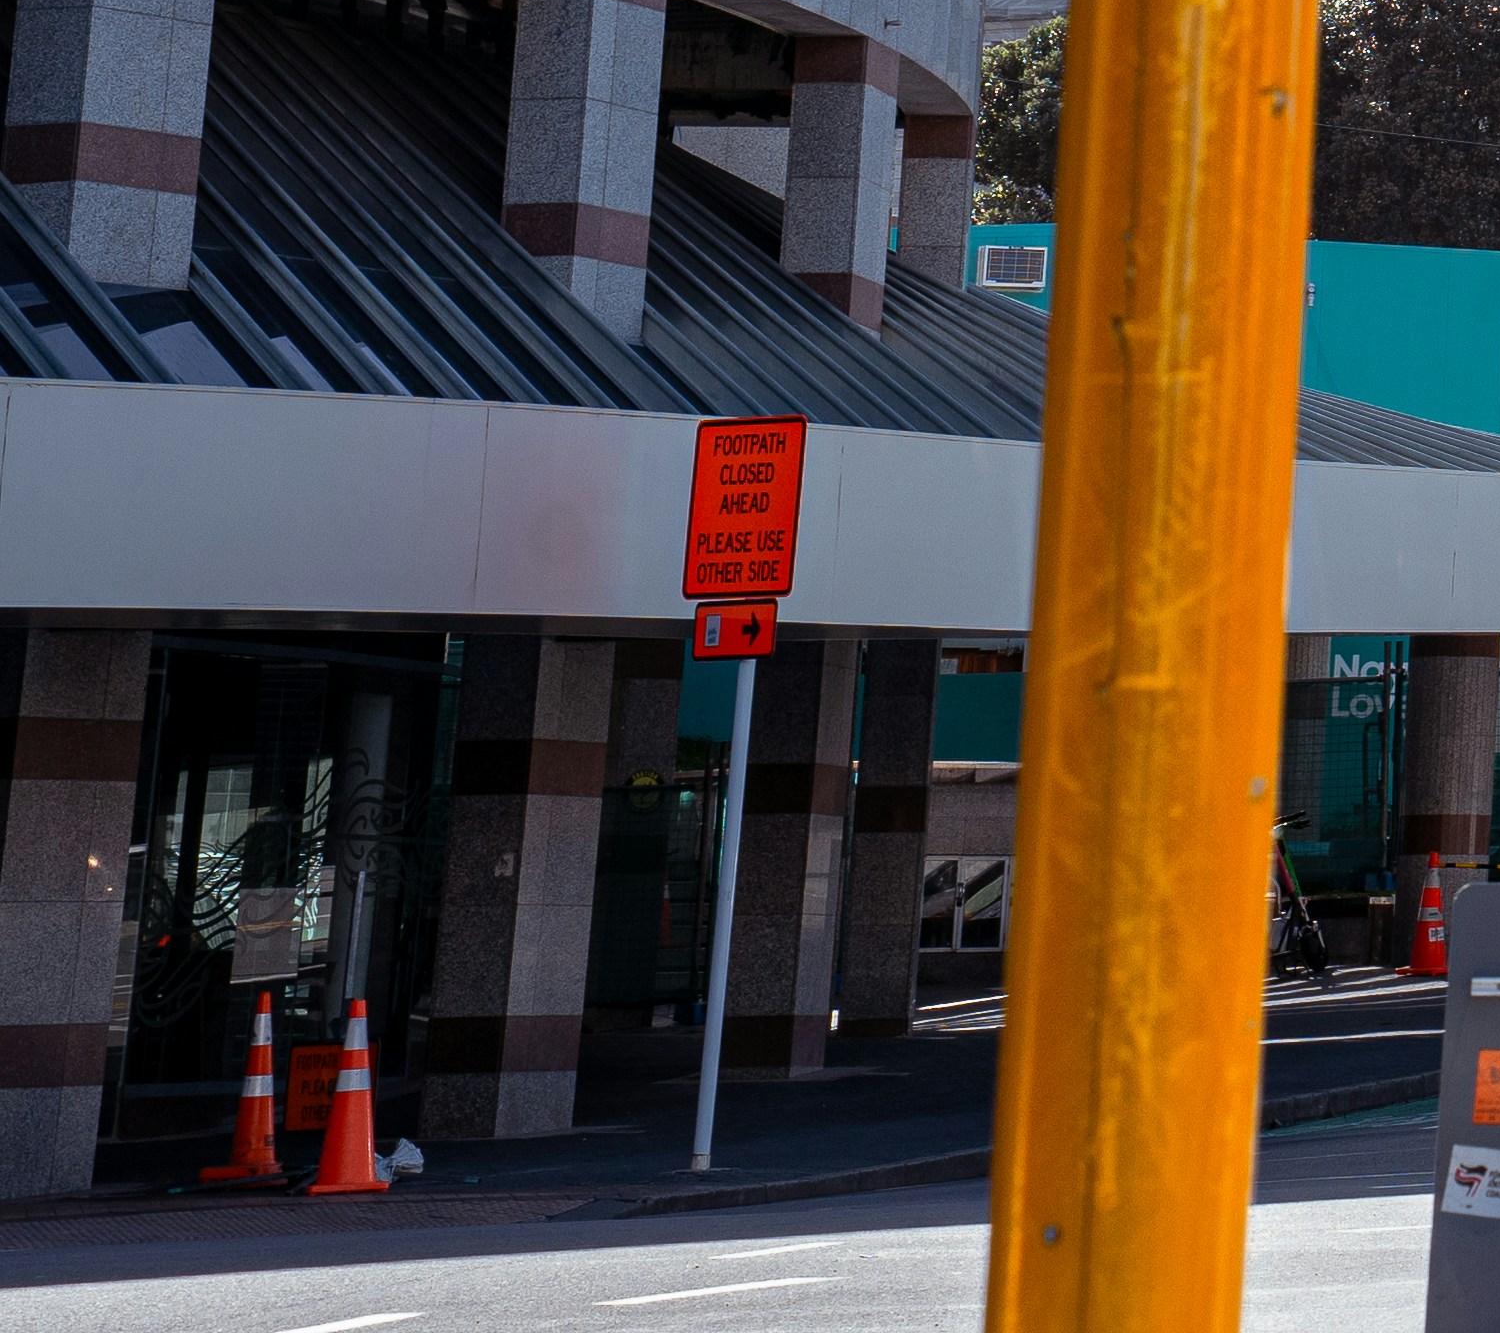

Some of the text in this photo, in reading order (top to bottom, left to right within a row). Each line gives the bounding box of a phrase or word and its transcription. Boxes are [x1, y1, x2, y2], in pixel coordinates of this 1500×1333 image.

[713, 432, 787, 457] FOOTPATH
[719, 462, 775, 485] CLOSED
[719, 492, 770, 515] AHEAD
[696, 530, 785, 555] PLEASE USE
[697, 559, 780, 584] OTHER SIDE
